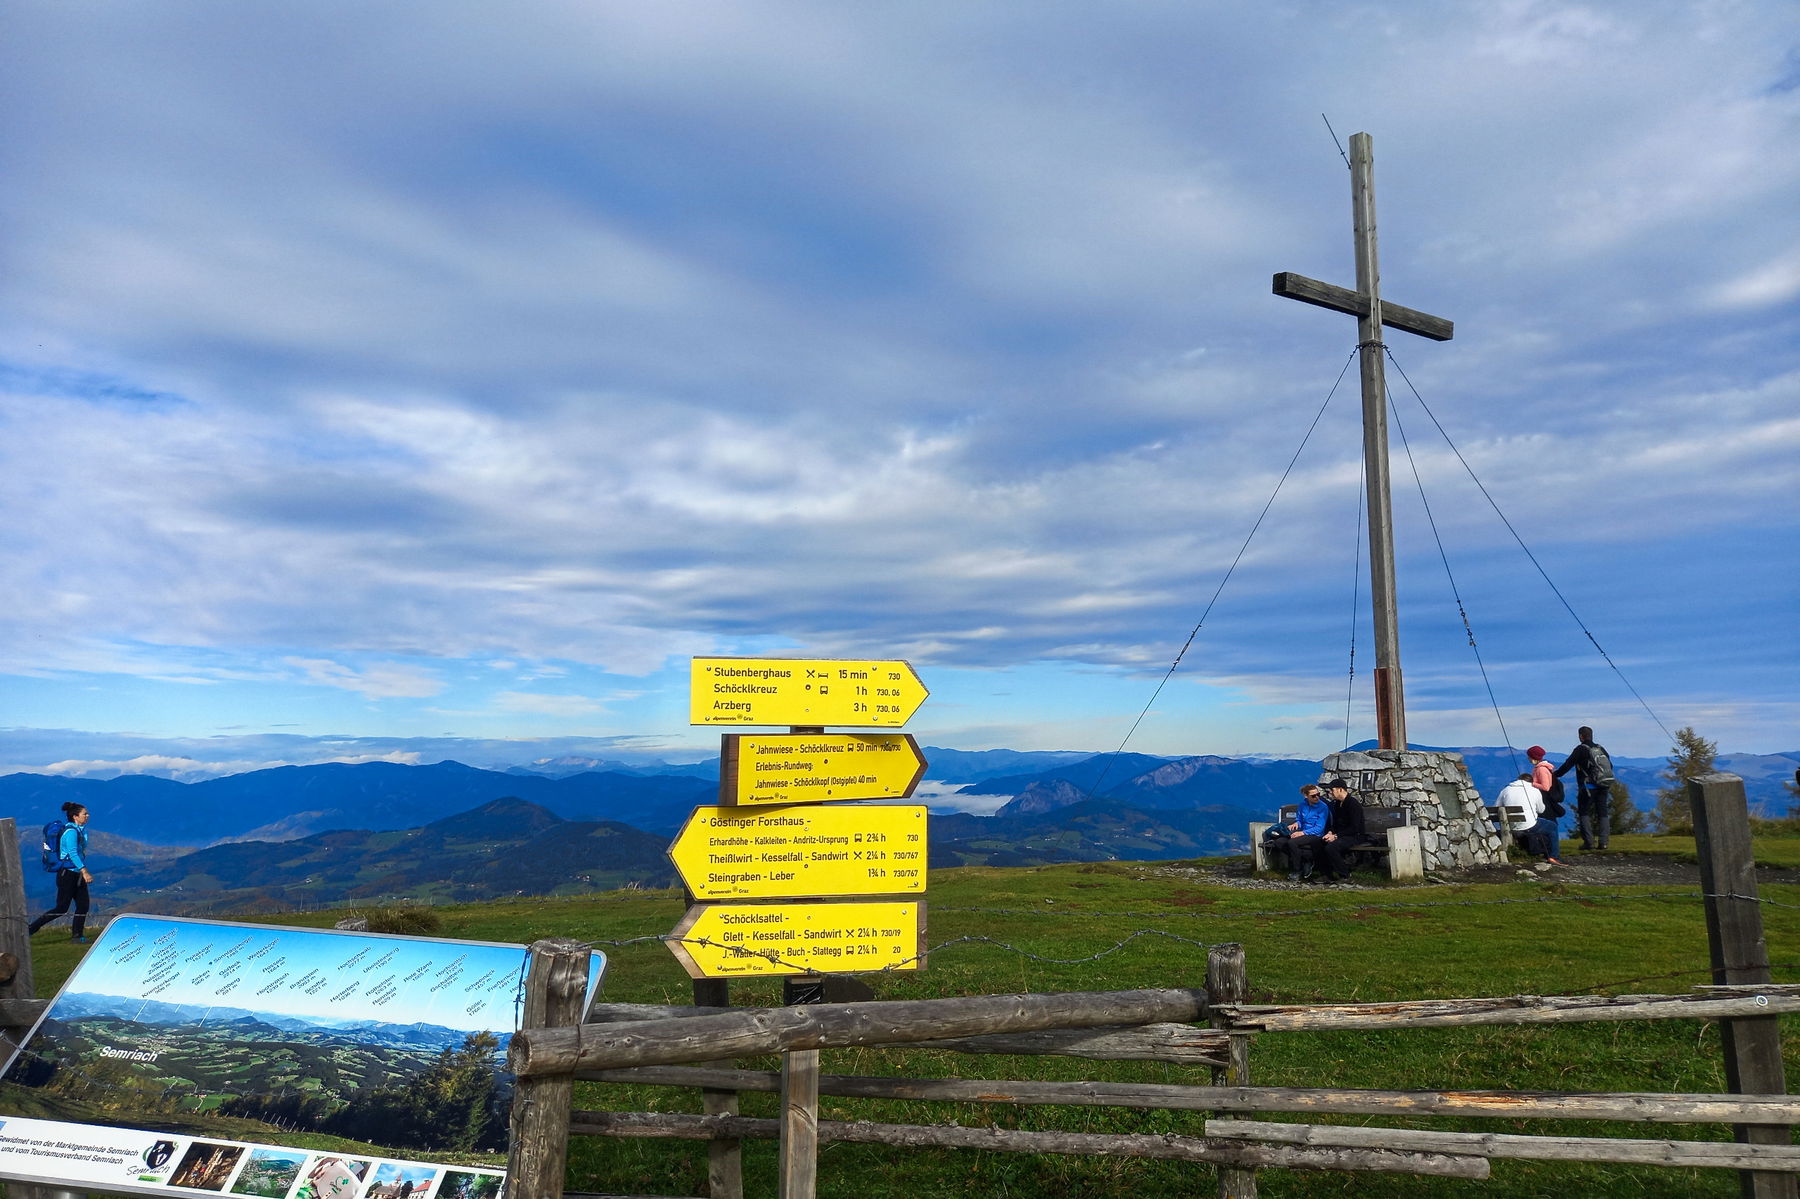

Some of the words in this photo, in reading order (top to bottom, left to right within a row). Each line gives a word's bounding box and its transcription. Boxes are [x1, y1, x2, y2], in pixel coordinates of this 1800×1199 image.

[714, 667, 791, 679] Stubenberghaus
[839, 670, 847, 678] 15
[850, 670, 867, 679] min
[714, 684, 777, 693] Schöcklkreuz
[856, 686, 859, 695] 1
[862, 686, 867, 695] h
[714, 700, 751, 712] Arzberg
[854, 703, 859, 711] 3
[862, 703, 867, 712] h
[756, 745, 793, 754] Jahnwiese
[800, 744, 844, 753] Schöcklkreuz
[857, 743, 864, 752] 50
[866, 744, 878, 752] min
[756, 761, 813, 771] Erlebnis-Rundweg:
[755, 779, 788, 788] Jahnwiese
[794, 777, 830, 787] Schöcklkopf
[831, 776, 857, 786] (Ostgipfel)
[858, 775, 865, 783] 40
[866, 775, 877, 783] min
[710, 817, 756, 829] Göstinger
[759, 816, 804, 826] Forsthaus
[710, 837, 748, 846] Erhardhöhe
[755, 837, 787, 845] Kalkleiten
[793, 836, 848, 845] Andritz-Ursprung
[881, 833, 886, 842] h
[709, 854, 752, 863] Theißlwirt
[762, 852, 802, 862] Kesselfall
[812, 851, 848, 860] Sandwirt
[881, 851, 885, 859] h
[709, 872, 760, 884] Steingraben
[770, 871, 795, 880] Leber
[881, 868, 885, 877] h
[723, 914, 783, 924] Schöcklsattel
[723, 932, 743, 941] Glett
[753, 930, 795, 940] Kesselfall
[804, 929, 841, 939] Sandwirt
[872, 928, 877, 937] h
[881, 929, 901, 937] 730/19
[787, 947, 805, 956] Buch
[813, 947, 841, 957] Stattegg
[872, 945, 877, 954] h
[100, 1046, 158, 1062] Semriach
[0, 1135, 29, 1144] Gewidmet
[56, 1141, 106, 1154] Marktgemeinde
[106, 1146, 138, 1156] Semriach
[30, 1148, 92, 1161] Tourismusverband
[92, 1154, 124, 1164] Semriach
